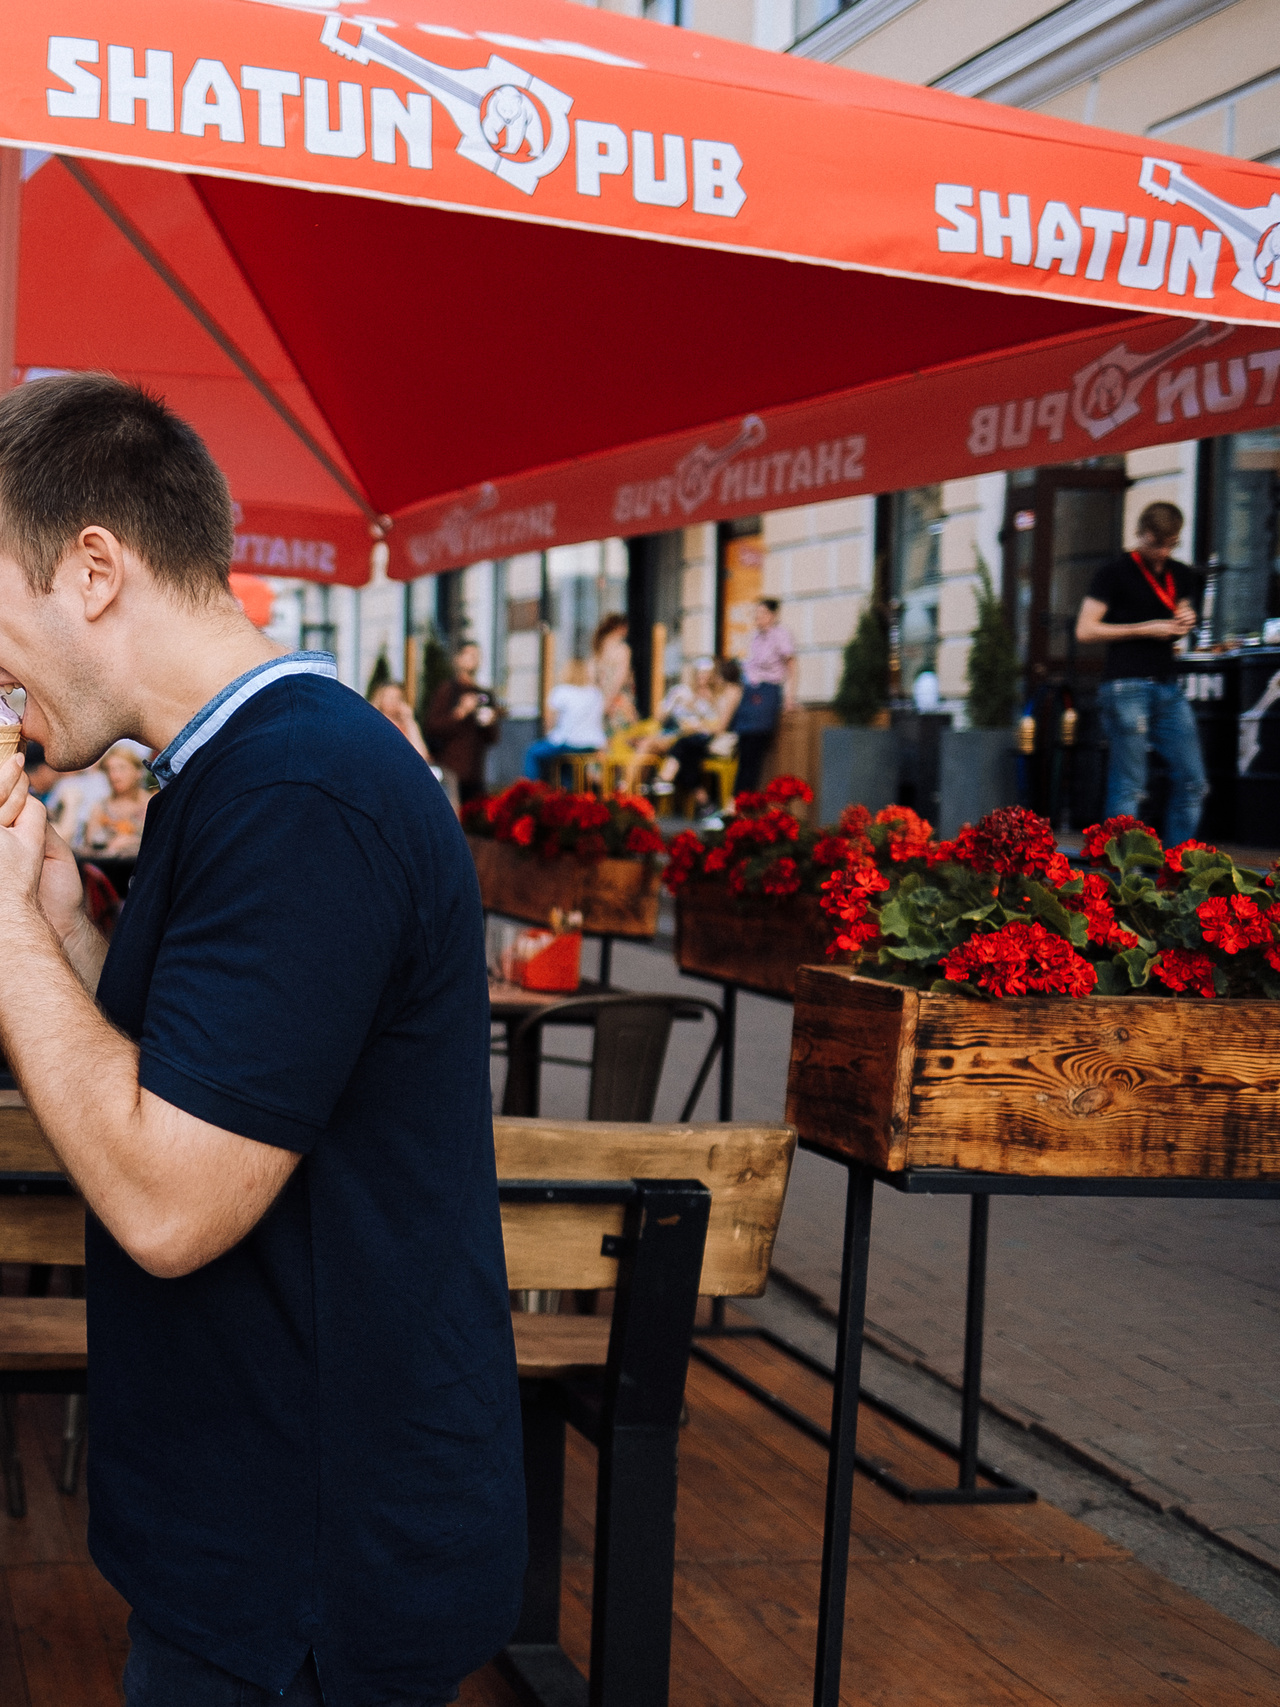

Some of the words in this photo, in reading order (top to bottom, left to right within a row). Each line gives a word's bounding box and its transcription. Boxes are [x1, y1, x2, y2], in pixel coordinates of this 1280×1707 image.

[45, 35, 433, 170] SHATUN
[575, 118, 747, 218] PUB
[934, 183, 1222, 299] SHATUN
